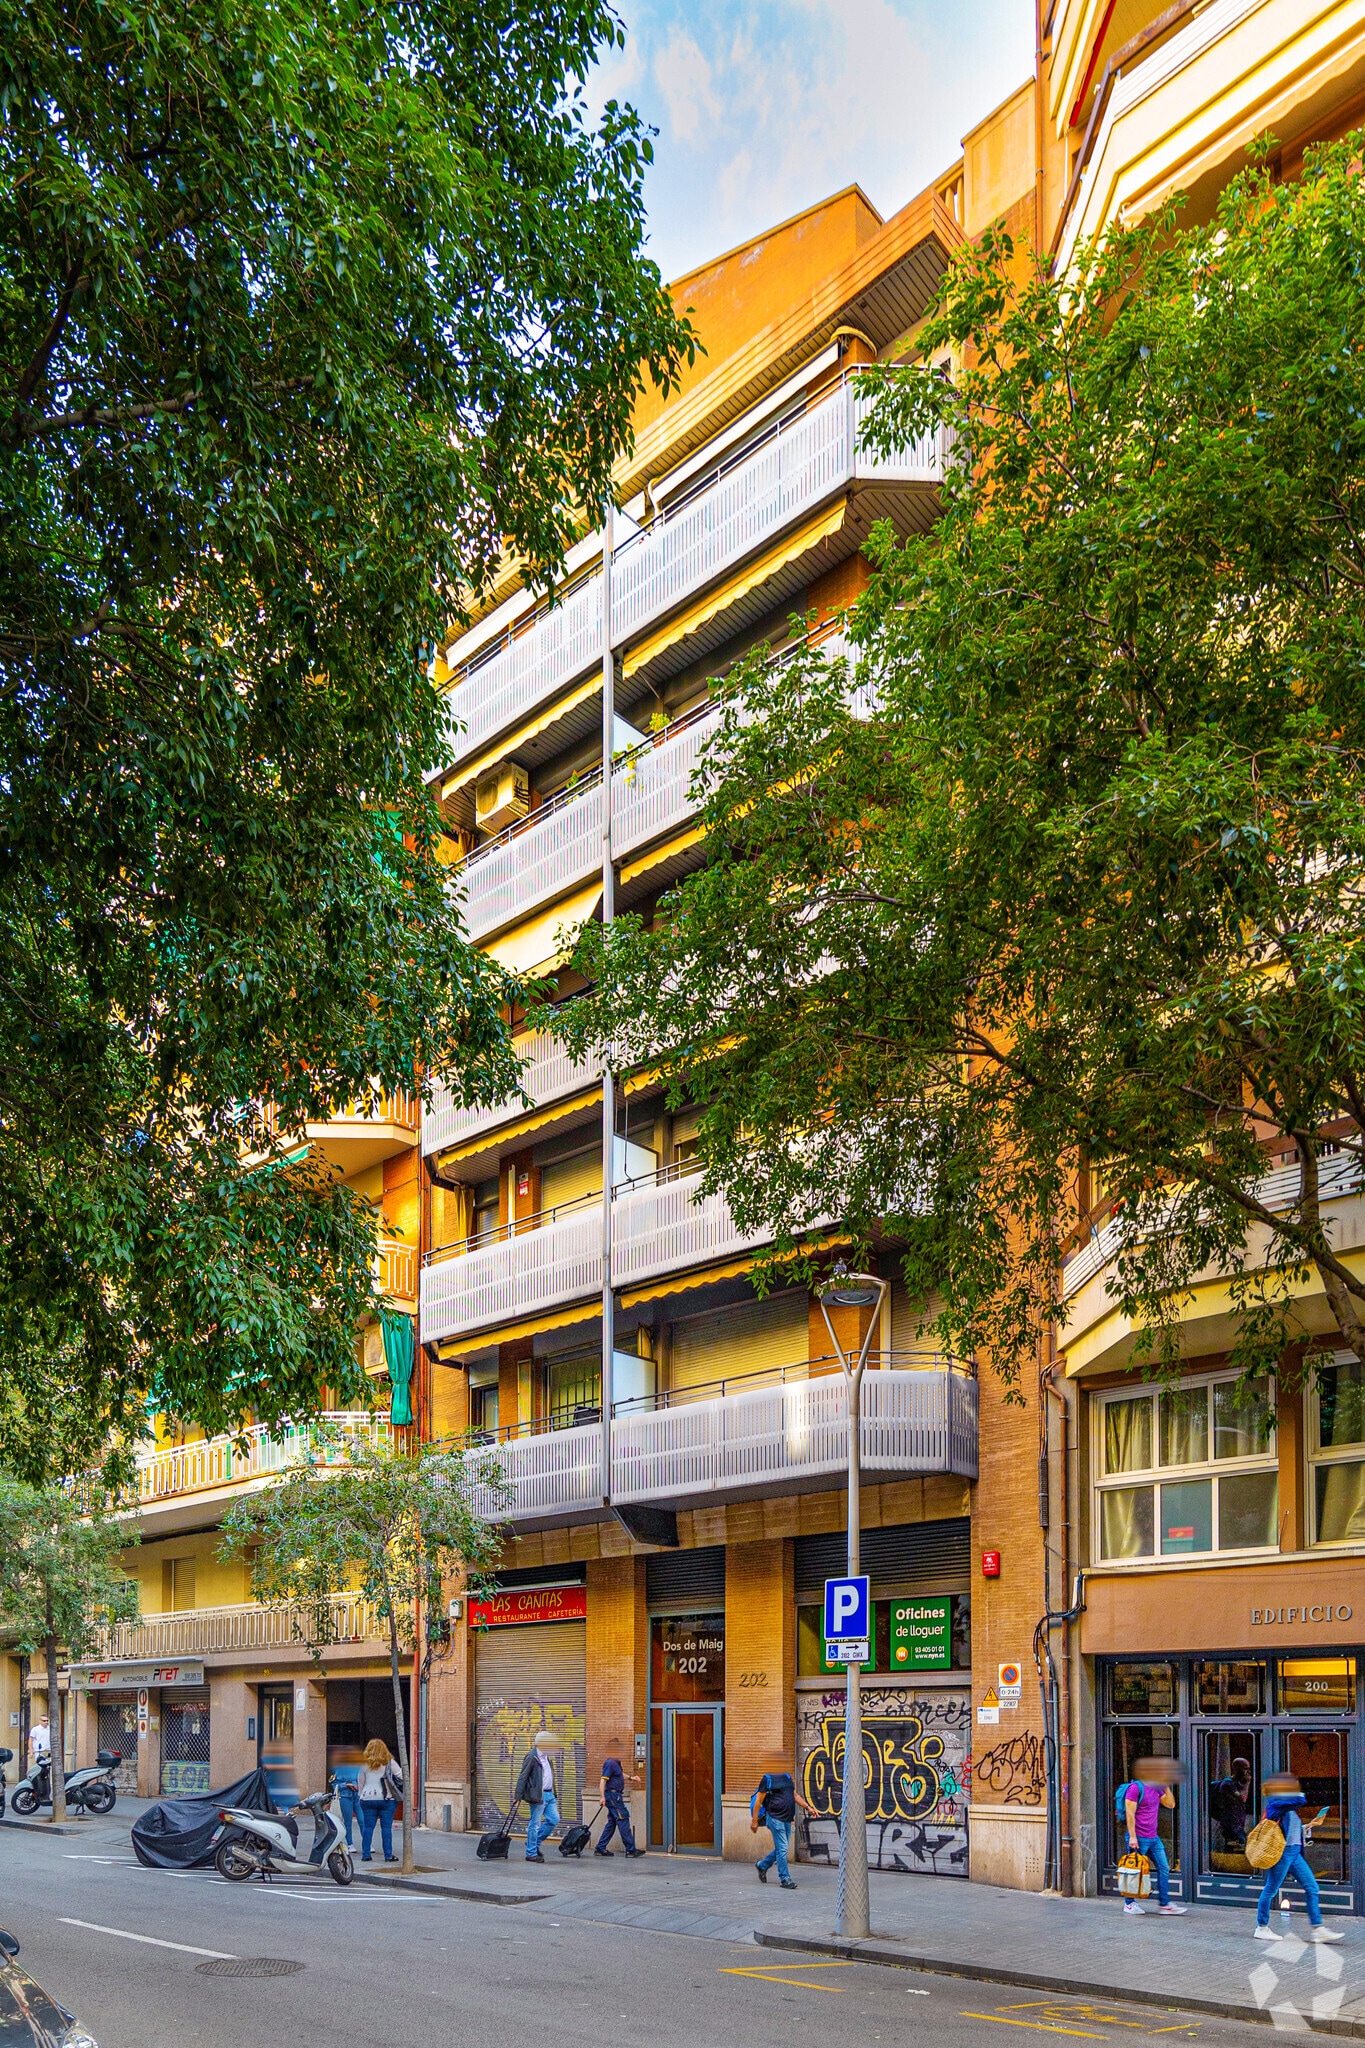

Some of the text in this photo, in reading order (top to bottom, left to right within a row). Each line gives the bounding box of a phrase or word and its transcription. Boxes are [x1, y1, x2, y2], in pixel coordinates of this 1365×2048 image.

[491, 1590, 563, 1612] LAS CAÑITAS
[833, 1585, 860, 1632] P
[472, 1605, 584, 1625] BA RESTAURANTE CAFETERÍA
[896, 1607, 945, 1620] Oficines
[1251, 1604, 1352, 1625] EDIFICIO
[896, 1625, 945, 1638] de lloguer
[663, 1638, 723, 1652] Dos de Maig
[679, 1656, 707, 1673] 202
[739, 1671, 768, 1688] 202
[1305, 1681, 1328, 1691] 200
